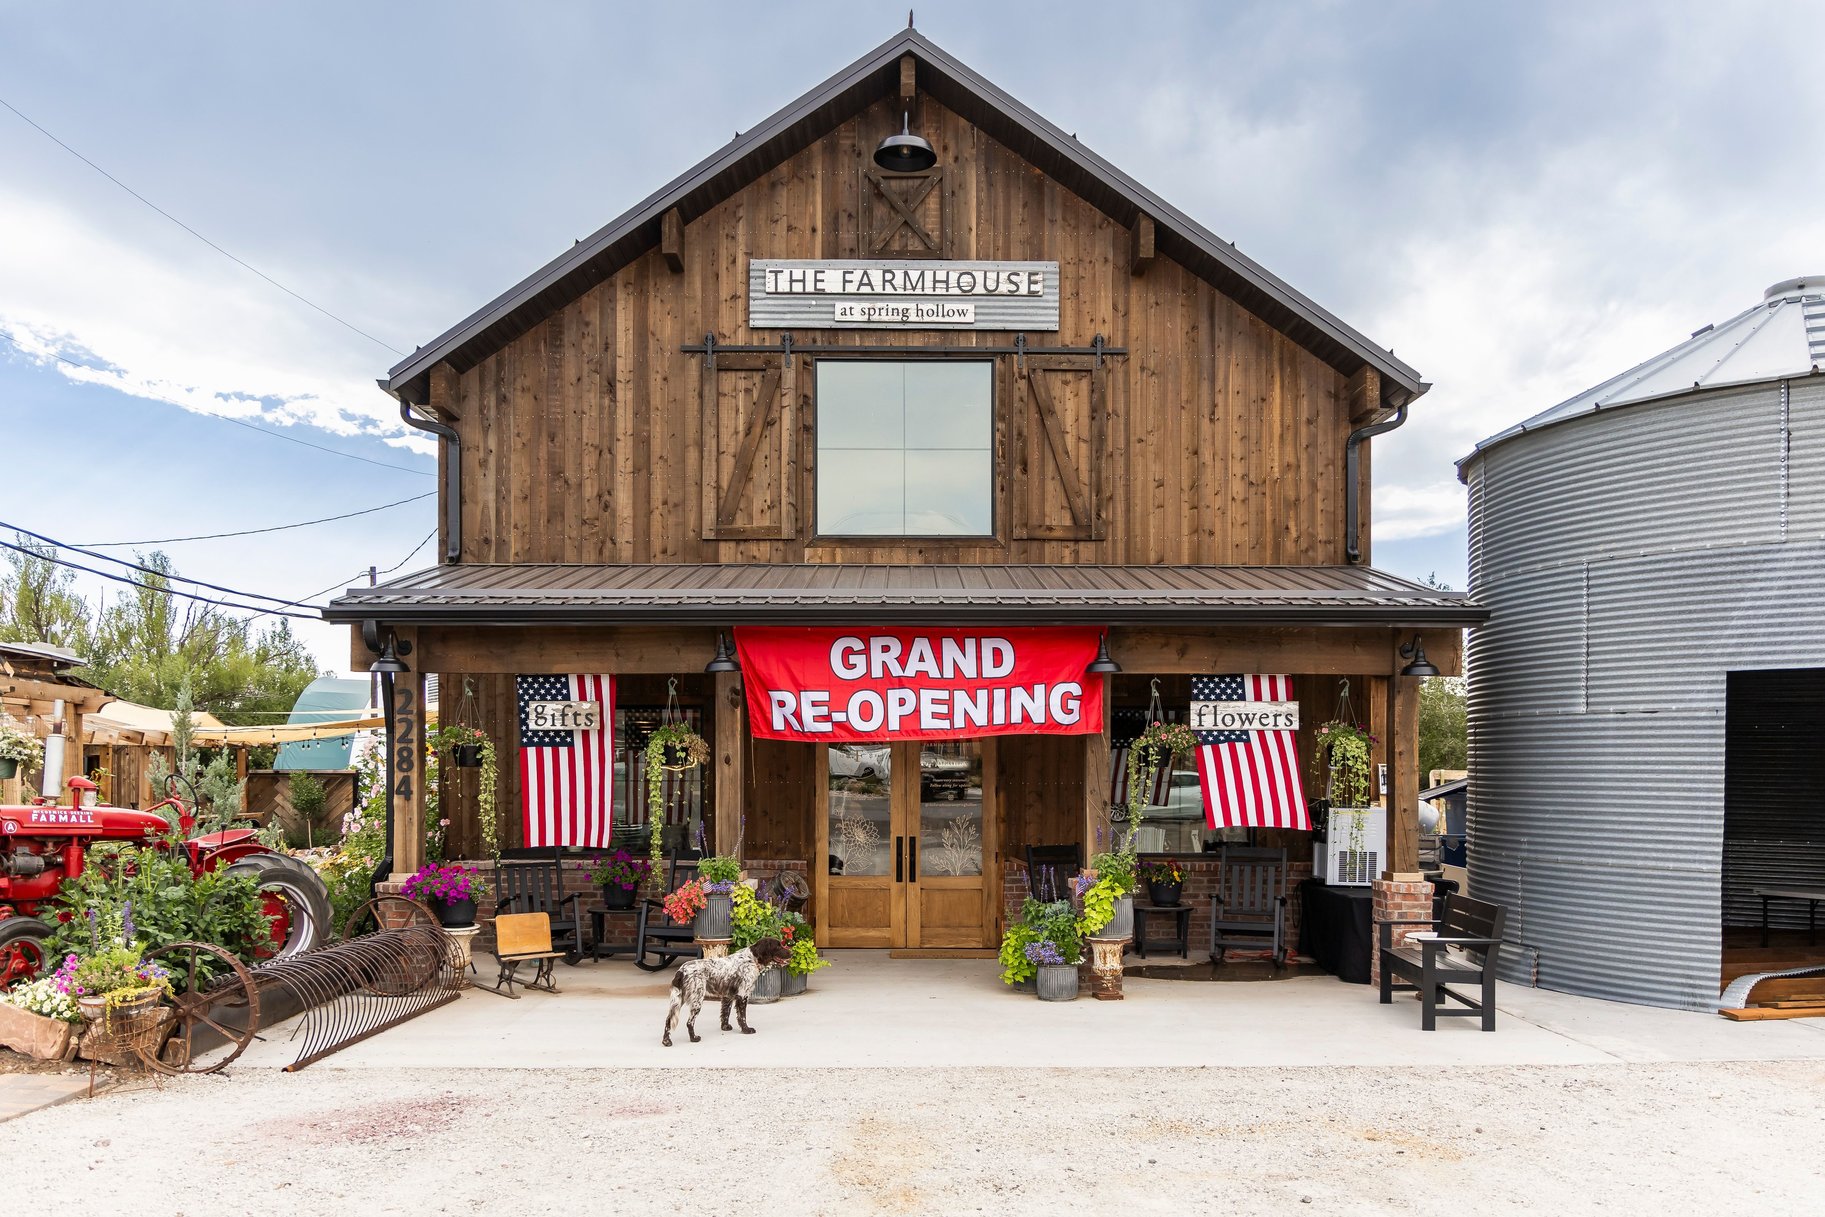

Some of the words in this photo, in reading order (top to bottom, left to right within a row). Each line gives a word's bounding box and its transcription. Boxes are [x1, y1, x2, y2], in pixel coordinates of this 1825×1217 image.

[768, 269, 826, 292] THE
[842, 268, 1041, 294] FARMHOUSE
[840, 305, 855, 317] at
[860, 304, 910, 321] spring
[916, 303, 969, 318] hollow
[829, 635, 1016, 680] GRAND
[534, 704, 594, 727] gifts
[767, 681, 1083, 733] RE-OPENING
[1196, 704, 1294, 727] flowers
[395, 688, 414, 801] 2284
[31, 813, 95, 823] FARMALL
